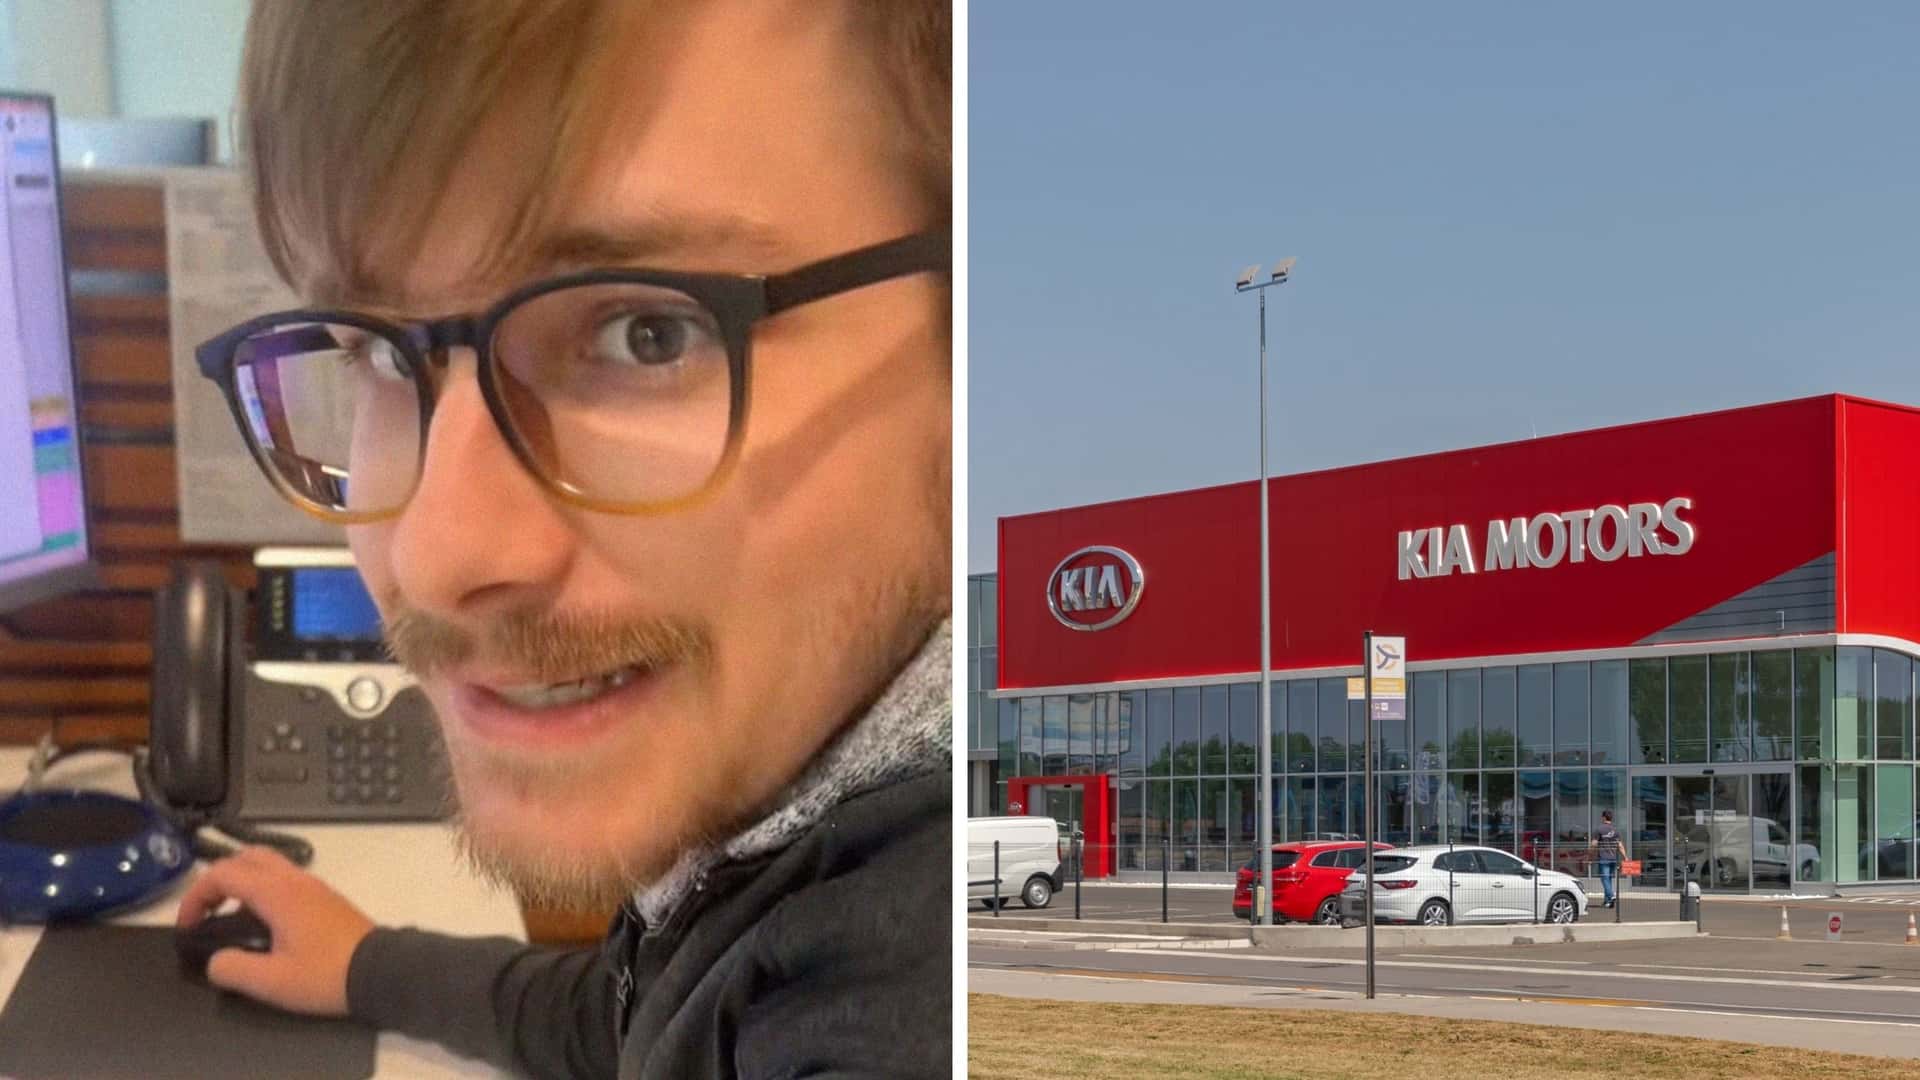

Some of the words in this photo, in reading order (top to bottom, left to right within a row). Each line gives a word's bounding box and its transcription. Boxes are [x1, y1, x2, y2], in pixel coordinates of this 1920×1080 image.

[1398, 524, 1475, 580] KIA
[1485, 497, 1694, 571] MOTORS
[1061, 565, 1125, 612] KIA
